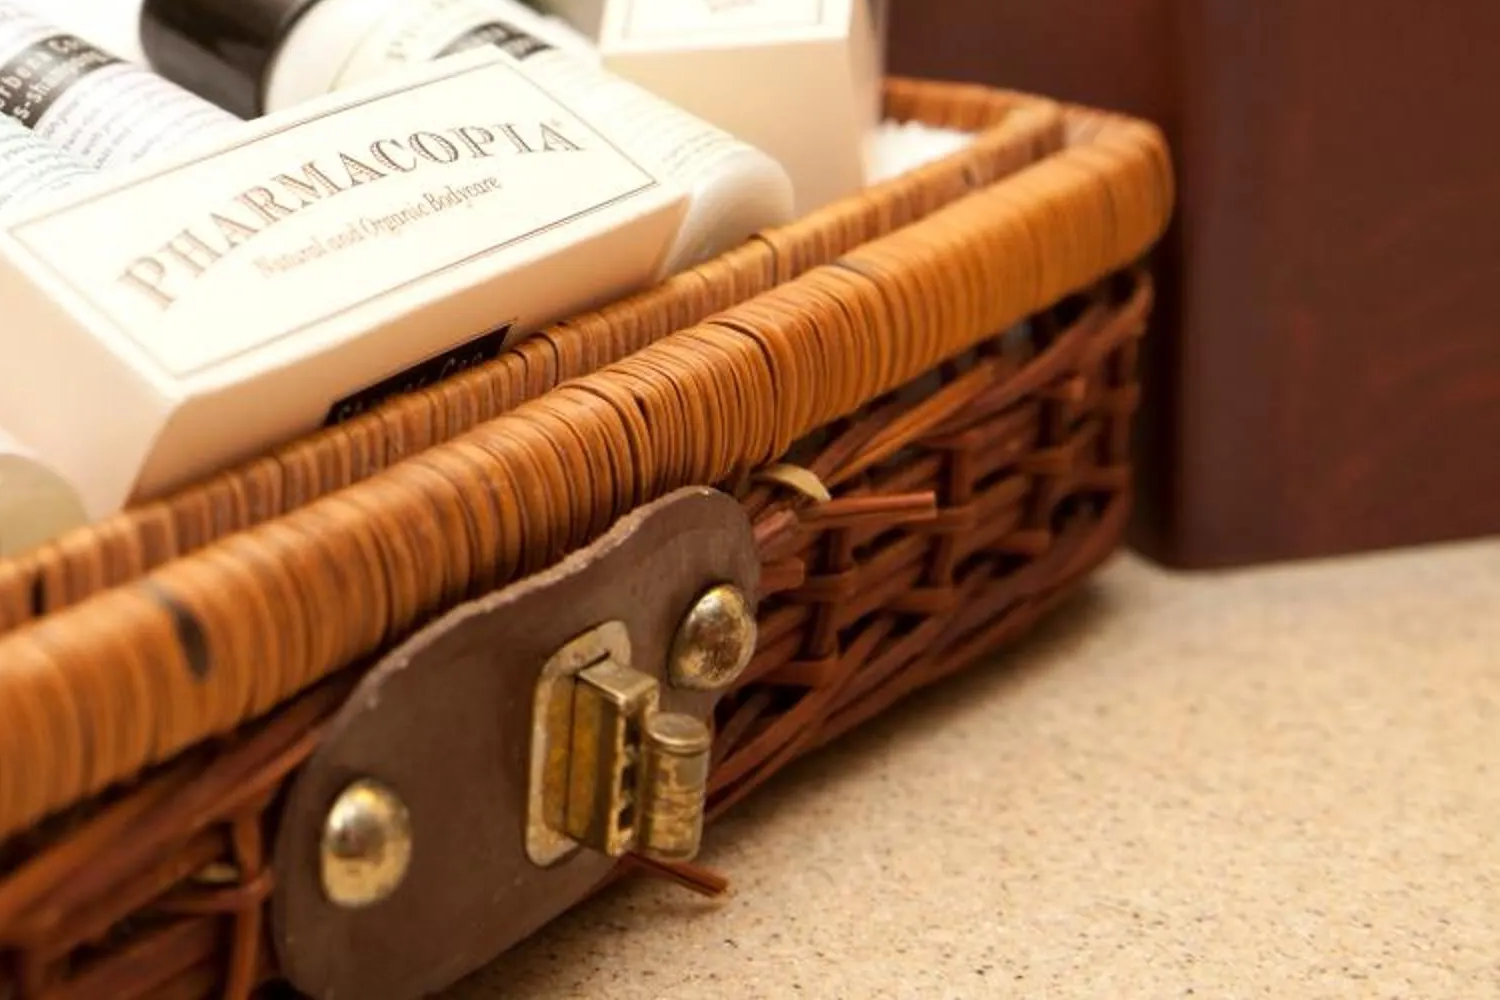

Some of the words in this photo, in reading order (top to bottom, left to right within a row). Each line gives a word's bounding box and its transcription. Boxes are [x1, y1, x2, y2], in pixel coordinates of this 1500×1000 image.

[115, 119, 587, 311] PHARMACOPIA
[250, 235, 328, 280] Natural
[327, 222, 365, 251] and
[359, 202, 431, 240] Organic
[422, 175, 503, 213] Bodycare
